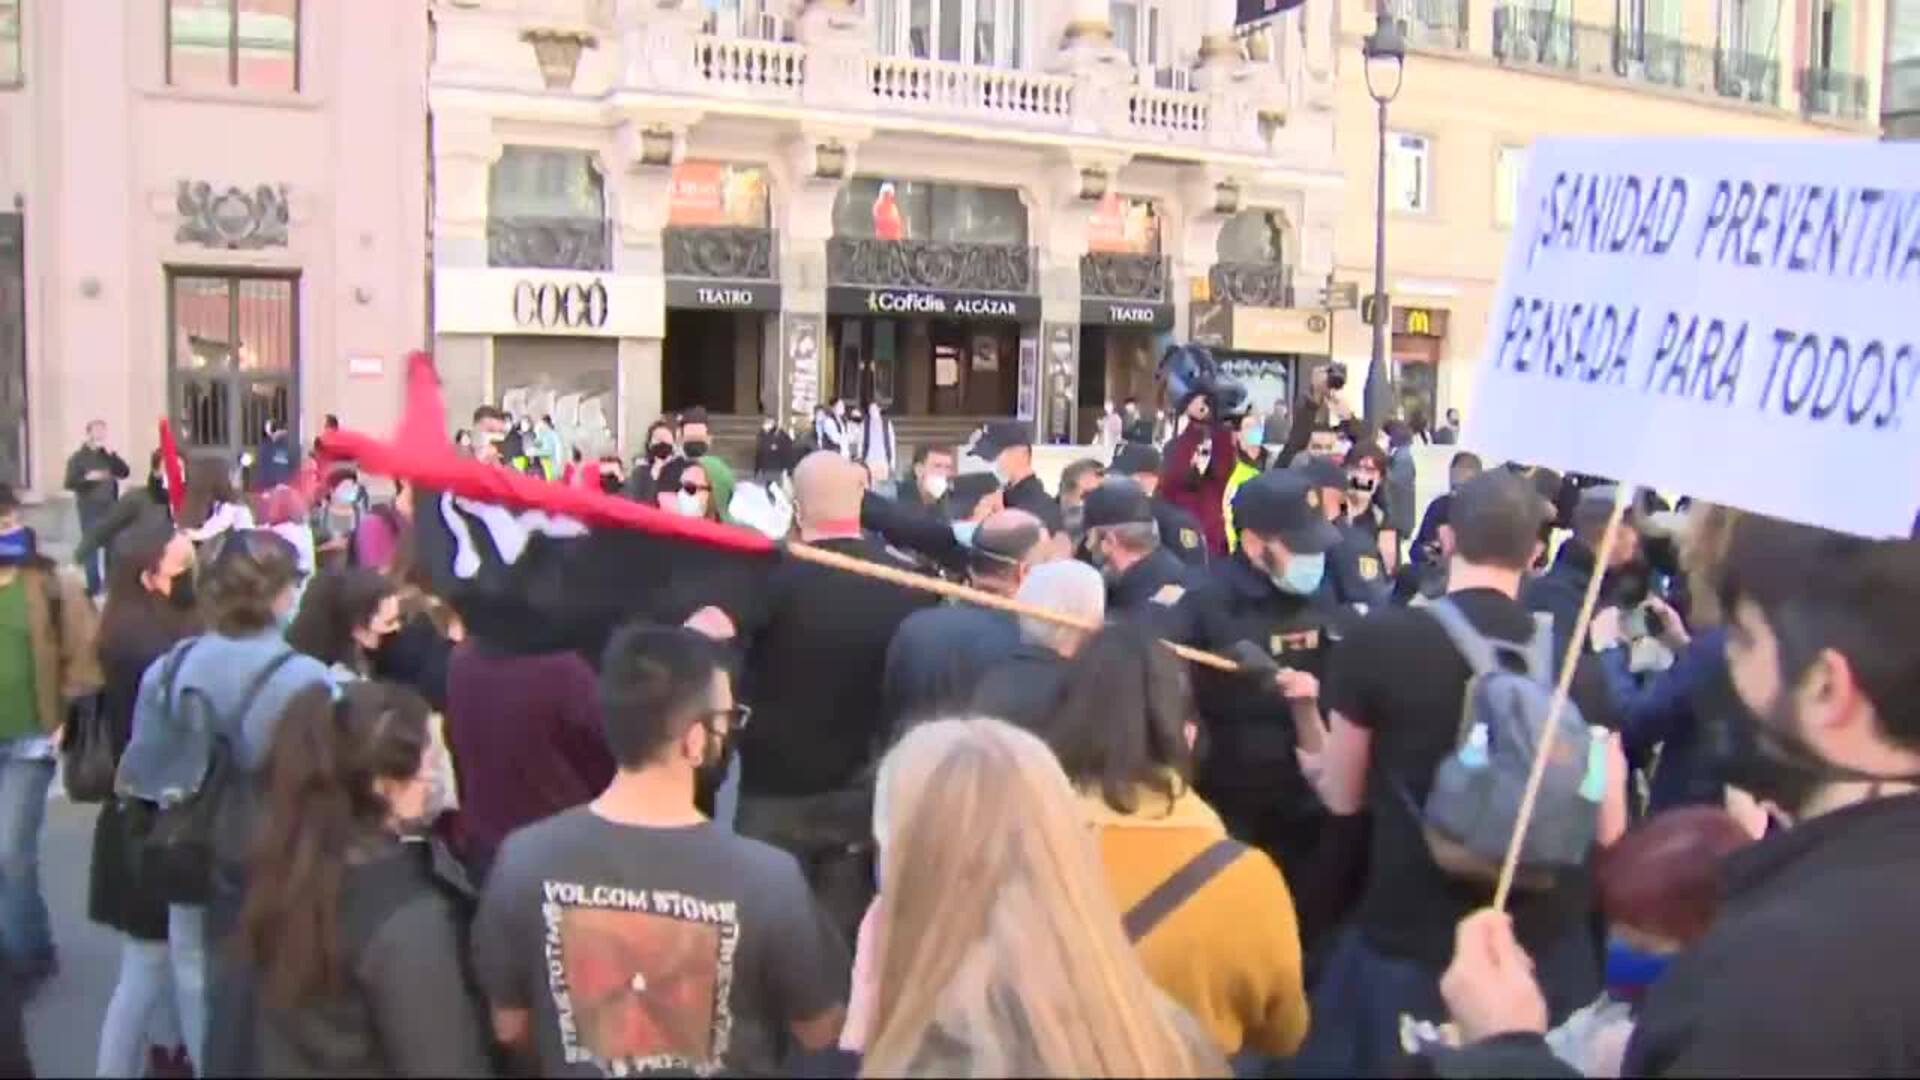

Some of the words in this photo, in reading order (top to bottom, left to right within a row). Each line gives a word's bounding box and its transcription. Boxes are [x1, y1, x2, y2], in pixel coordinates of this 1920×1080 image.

[698, 287, 753, 305] TEATRO
[878, 292, 945, 313] Cofidis
[953, 298, 1016, 316] ALCÁZAR
[1110, 304, 1154, 322] TEATRO
[1497, 296, 1640, 384] PENSADA
[1643, 311, 1749, 409] PARA
[543, 880, 649, 911] VOLCOM
